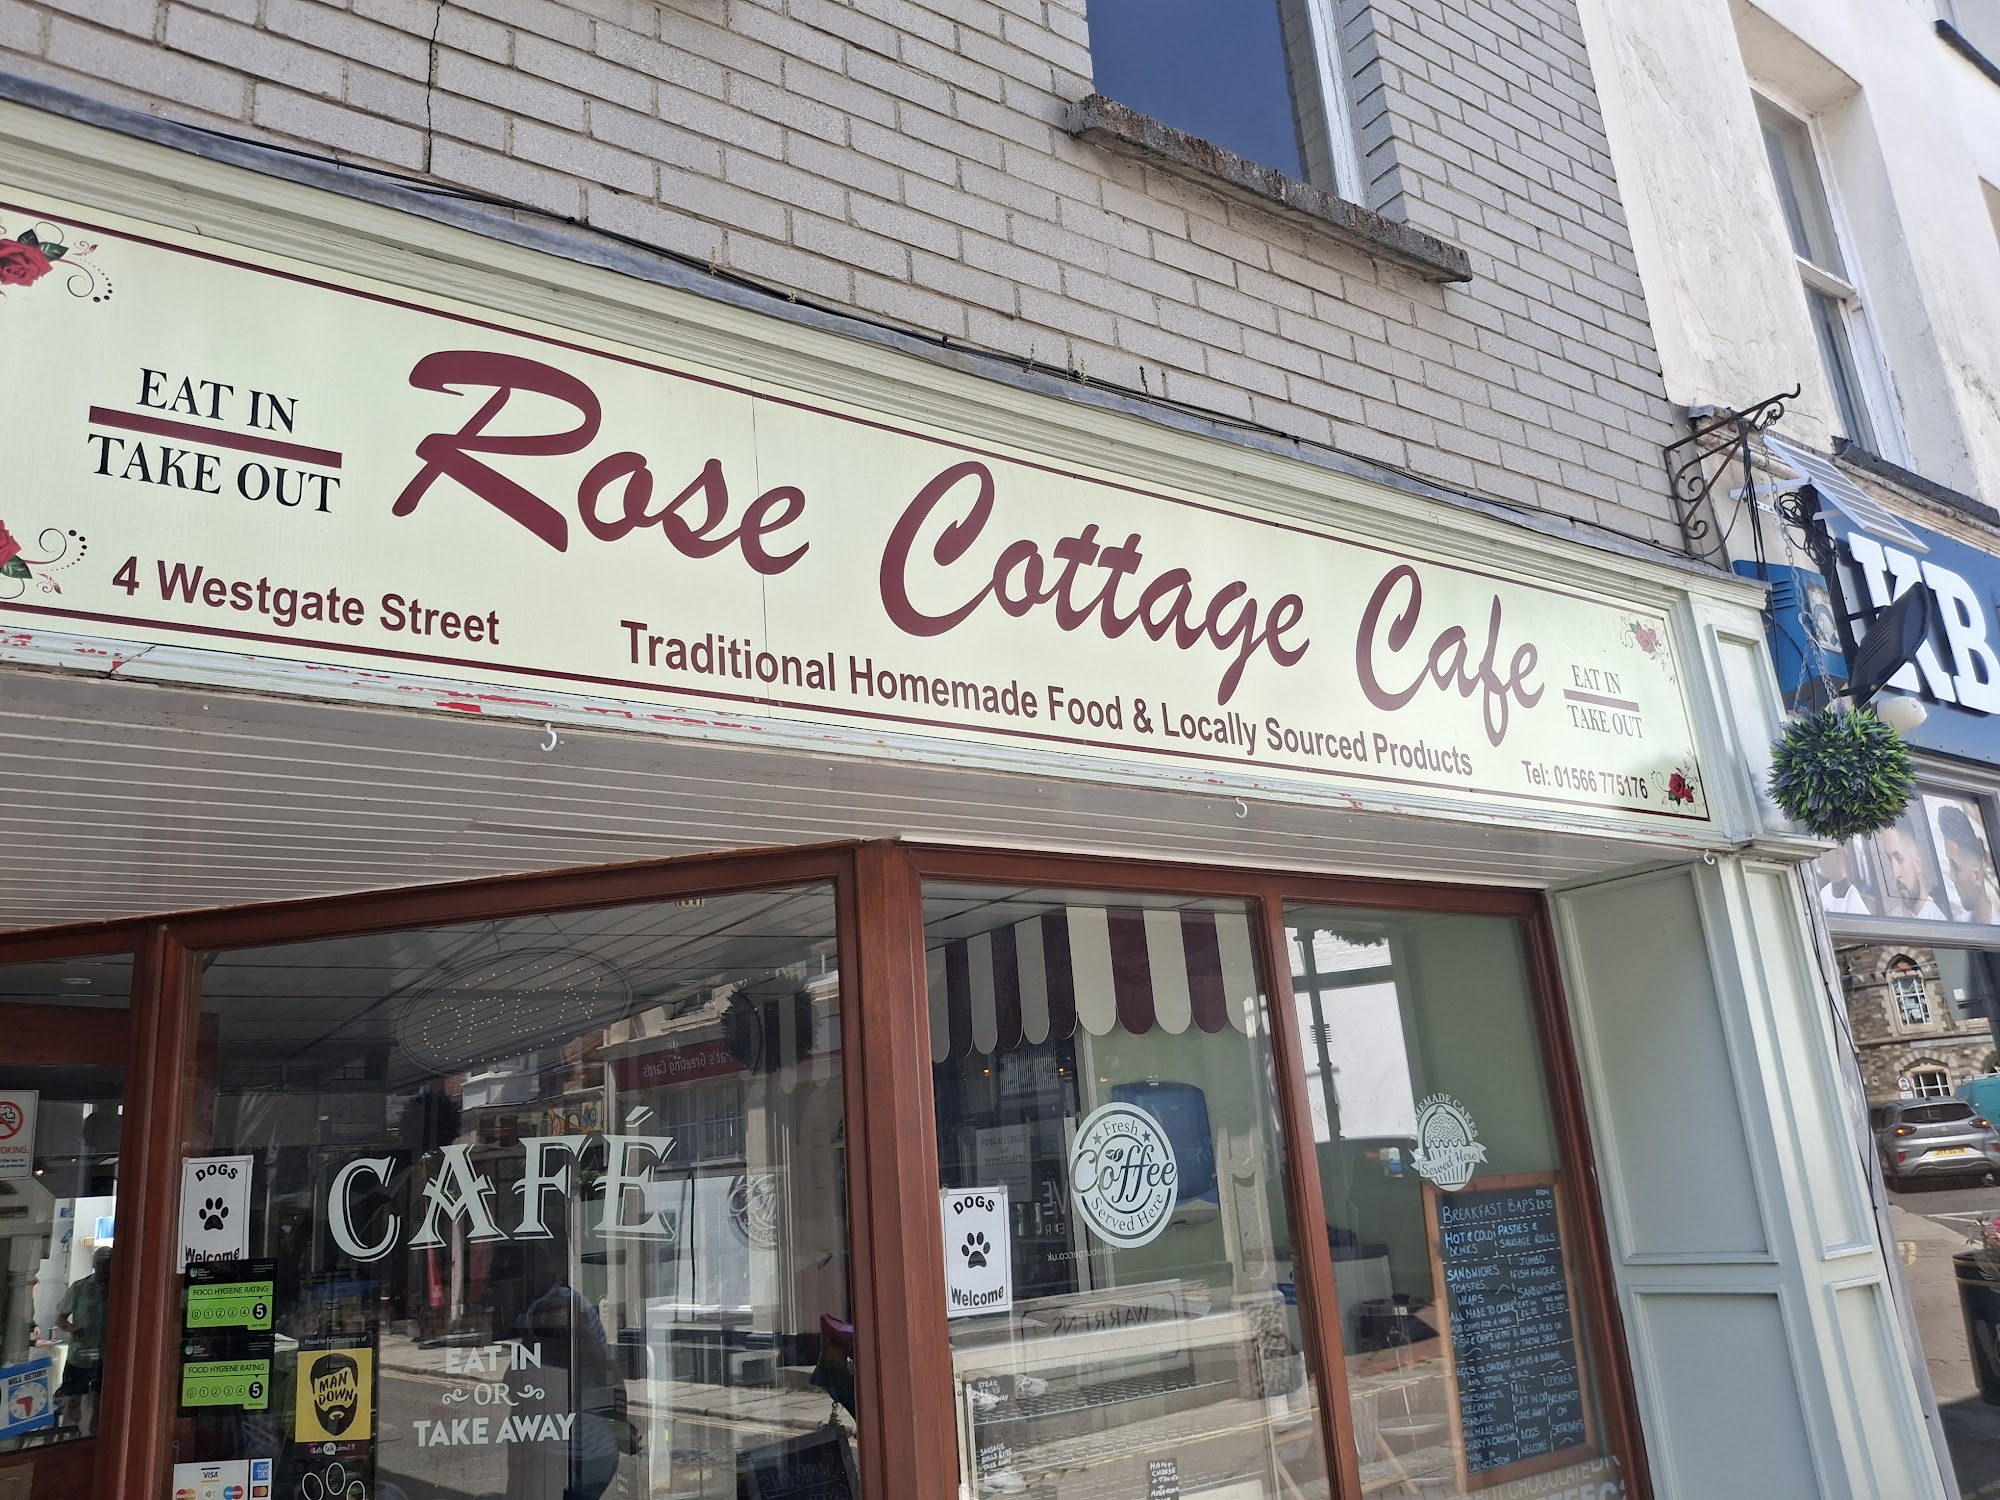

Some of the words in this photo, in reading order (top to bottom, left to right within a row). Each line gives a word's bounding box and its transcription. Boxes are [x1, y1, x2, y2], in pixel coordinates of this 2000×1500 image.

[136, 367, 234, 422] EAT
[246, 390, 299, 434] IN
[87, 433, 222, 495] TAKE
[237, 461, 342, 514] OUT
[391, 349, 810, 576] Rose
[880, 460, 1311, 708] Cottage
[1356, 564, 1546, 748] Cafe
[111, 555, 140, 597] 4
[157, 560, 365, 627] Westgate
[379, 593, 501, 645] Street
[1571, 664, 1599, 690] EAT
[1600, 672, 1623, 695] IN
[620, 619, 835, 691] Traditional
[848, 654, 1038, 720] Homemade
[1047, 685, 1123, 731] Food
[1132, 698, 1154, 734] &
[1161, 702, 1257, 756] Locally
[1266, 717, 1367, 763] Sourced
[1373, 733, 1473, 777] Products
[1567, 705, 1609, 733] TAKE
[1611, 712, 1645, 740] OUT
[1521, 761, 1551, 787] Tel:
[1553, 765, 1598, 794] 01566
[1600, 771, 1649, 800] 775176
[424, 976, 602, 1050] OPEN
[1102, 1120, 1138, 1137] Fresh
[1453, 1099, 1479, 1138] CAKES
[0, 1146, 29, 1154] OKING.
[195, 1164, 238, 1182] DOGS
[1421, 1159, 1453, 1176] Served
[1454, 1150, 1478, 1164] Here
[328, 1106, 678, 1262] CAFÉ
[1070, 1144, 1178, 1204] Coffee
[953, 1195, 996, 1216] DOGS
[1091, 1196, 1135, 1232] Served
[1136, 1194, 1164, 1228] Here
[1442, 1202, 1502, 1224] BREAKFAST
[1508, 1198, 1535, 1213] BAPS
[1445, 1232, 1465, 1249] HOT
[1474, 1230, 1494, 1242] COLD
[1498, 1223, 1528, 1236] PASTIES
[1450, 1244, 1478, 1257] DRINKS
[1500, 1236, 1531, 1248] SAUSAGE
[1534, 1233, 1556, 1244] ROLLS
[185, 1245, 240, 1262] Welcome
[1519, 1255, 1545, 1265] JUMBO
[1447, 1264, 1499, 1281] SANDWICHES
[1513, 1268, 1530, 1279] FISH
[1530, 1265, 1556, 1278] FINGER
[214, 1287, 243, 1295] HYGIENE
[951, 1284, 1005, 1308] Welcome
[1458, 1294, 1484, 1306] WRAPS
[255, 1305, 264, 1318] 5
[1450, 1312, 1465, 1322] ALL
[1466, 1307, 1486, 1318] MADE
[1487, 1306, 1495, 1315] TO
[445, 1345, 502, 1374] EAT
[511, 1342, 542, 1370] IN
[188, 1366, 209, 1374] FOOD
[252, 1384, 260, 1396] 5
[319, 1371, 348, 1393] MAN
[318, 1388, 354, 1406] DOWN
[474, 1382, 519, 1407] OR
[413, 1418, 488, 1447] TAKE
[496, 1413, 577, 1442] AWAY
[1521, 1427, 1540, 1439] DOGS
[203, 1471, 218, 1479] VISA
